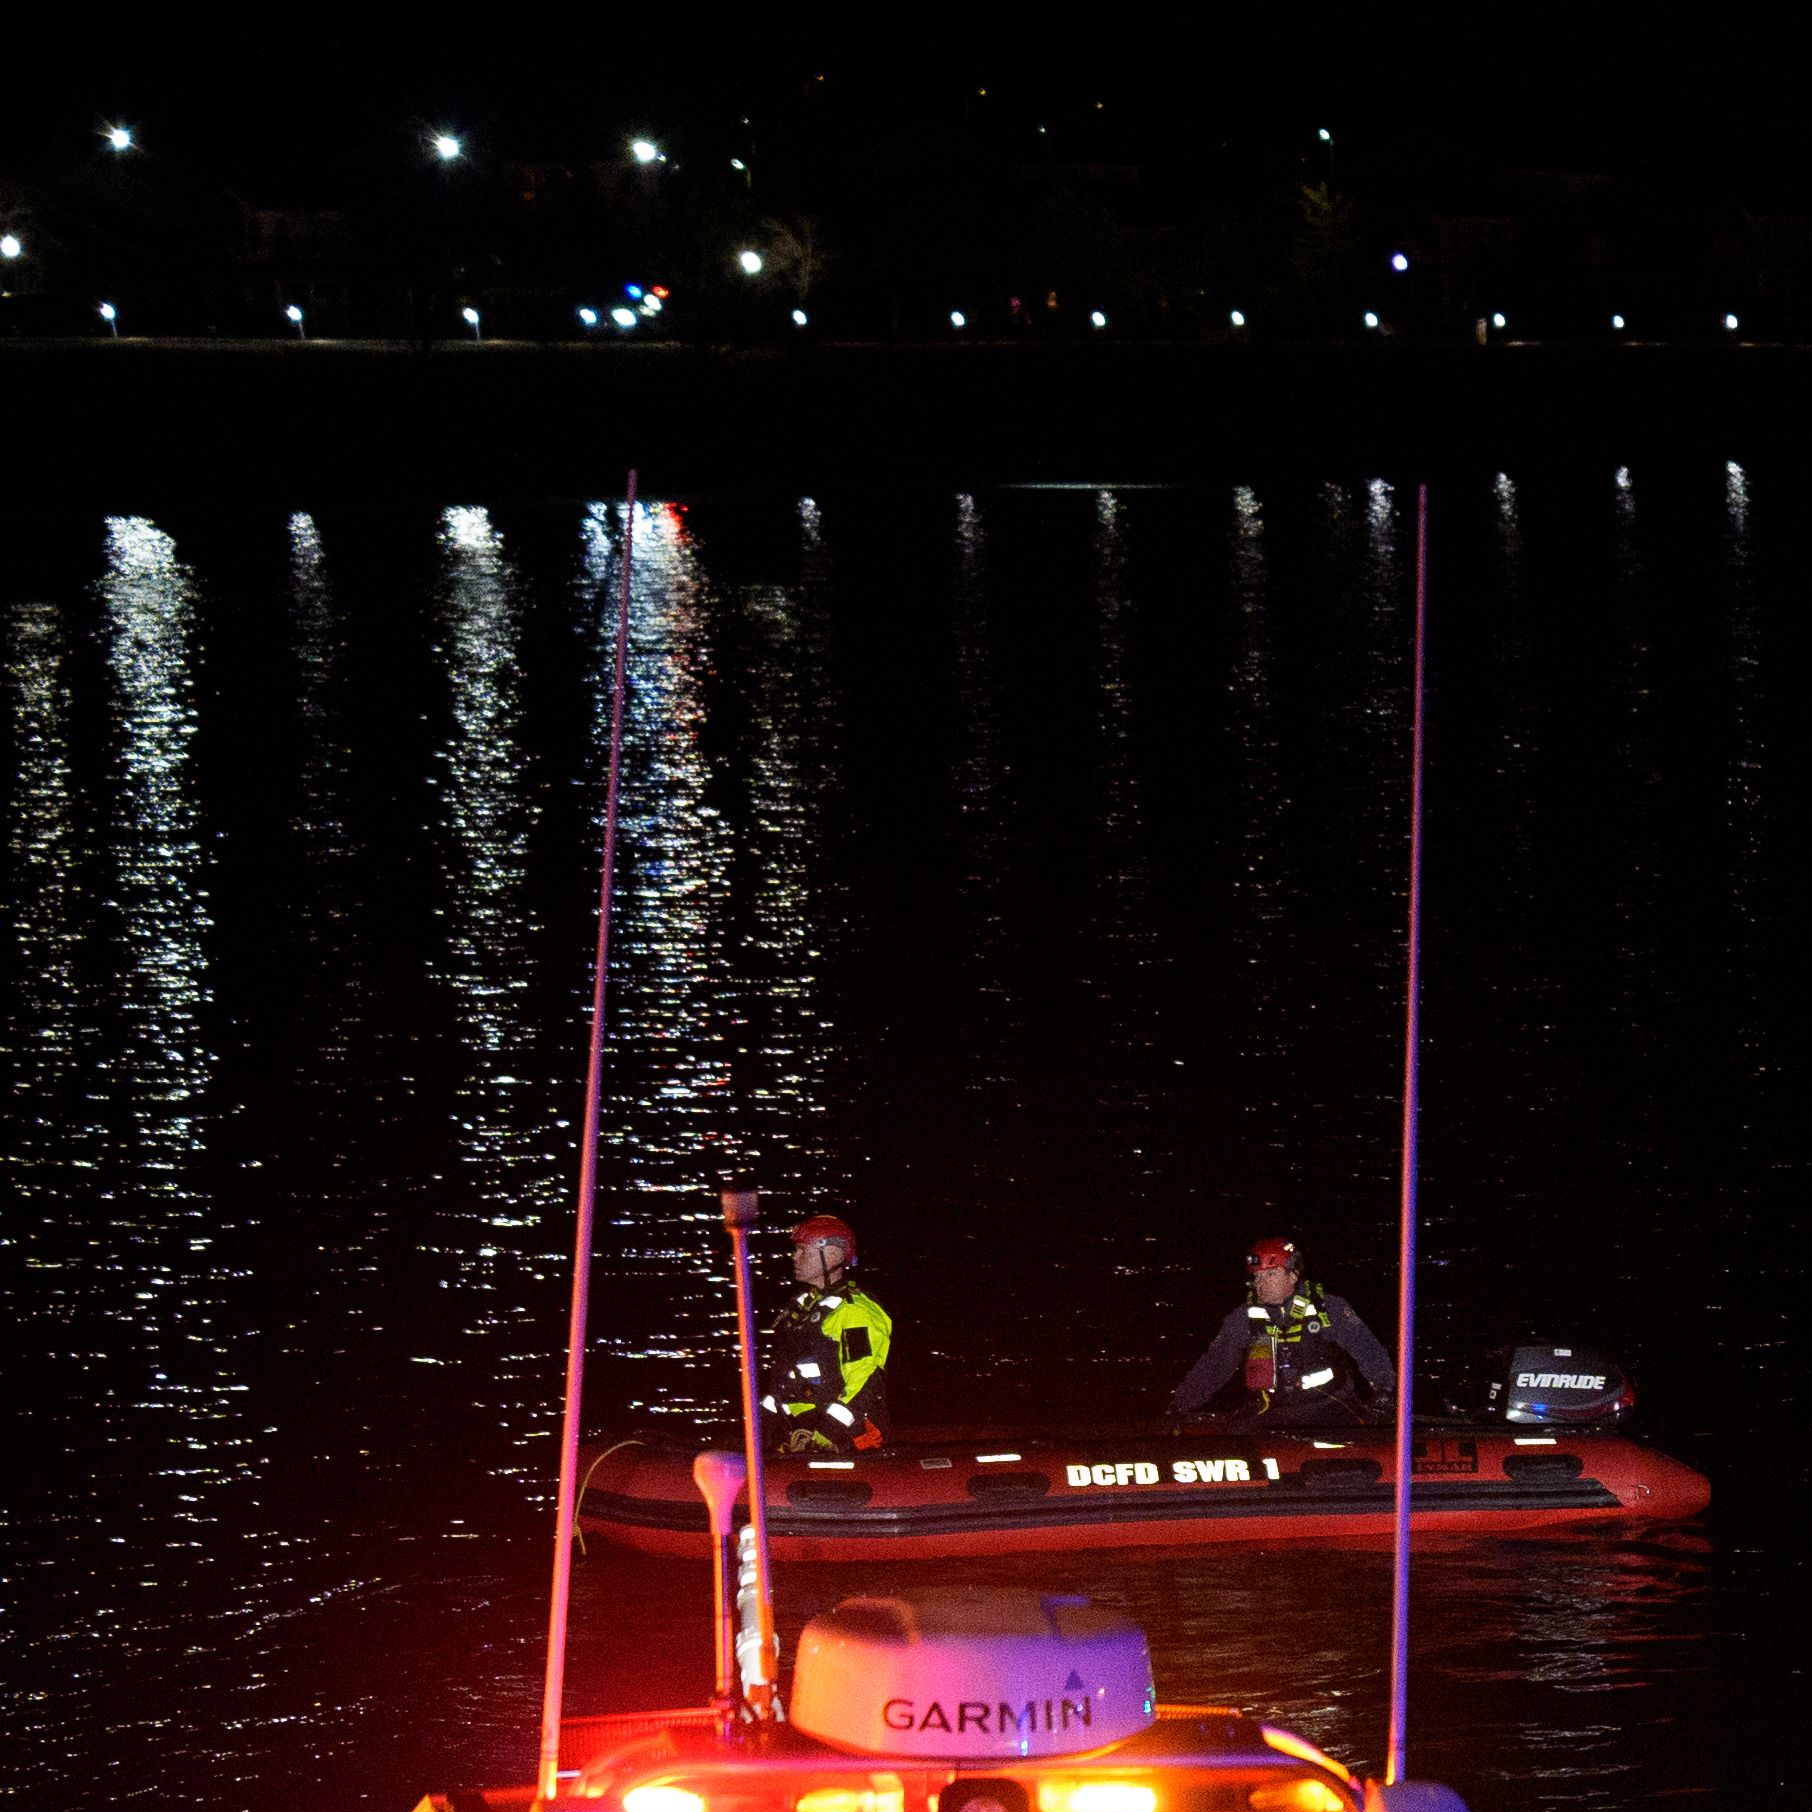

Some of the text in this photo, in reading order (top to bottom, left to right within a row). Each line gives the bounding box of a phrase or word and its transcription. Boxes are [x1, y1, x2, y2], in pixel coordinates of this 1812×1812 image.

[1516, 1372, 1606, 1390] EVINRUDE
[1066, 1457, 1280, 1487] DCFD SWR 1
[883, 1696, 1092, 1733] GARMIN
